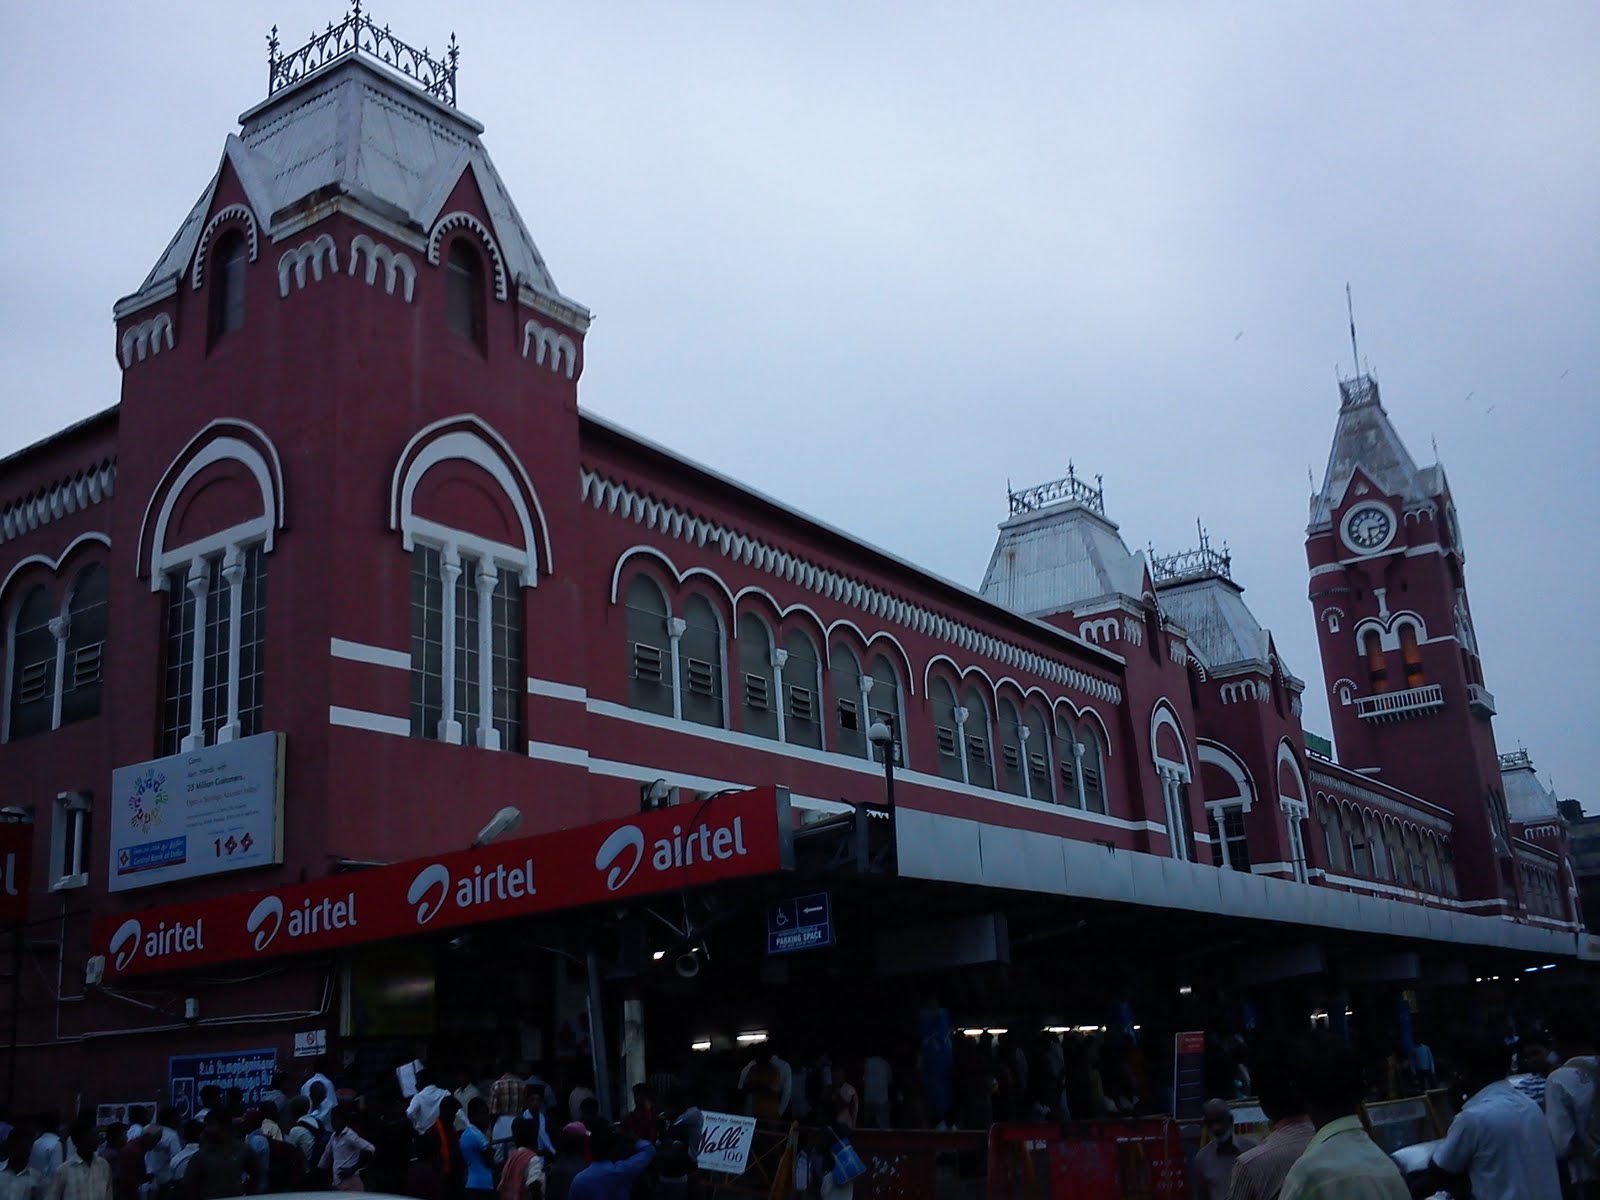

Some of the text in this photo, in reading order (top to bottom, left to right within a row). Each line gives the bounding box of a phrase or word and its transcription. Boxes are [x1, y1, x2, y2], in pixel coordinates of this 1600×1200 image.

[652, 816, 747, 871] airtel
[455, 859, 537, 908] airtel
[287, 892, 357, 937] airtel
[144, 918, 204, 958] airtel
[776, 934, 802, 947] PARKING
[802, 930, 822, 943] SPACE
[697, 1125, 744, 1156] Nalli
[723, 1150, 743, 1162] 100
